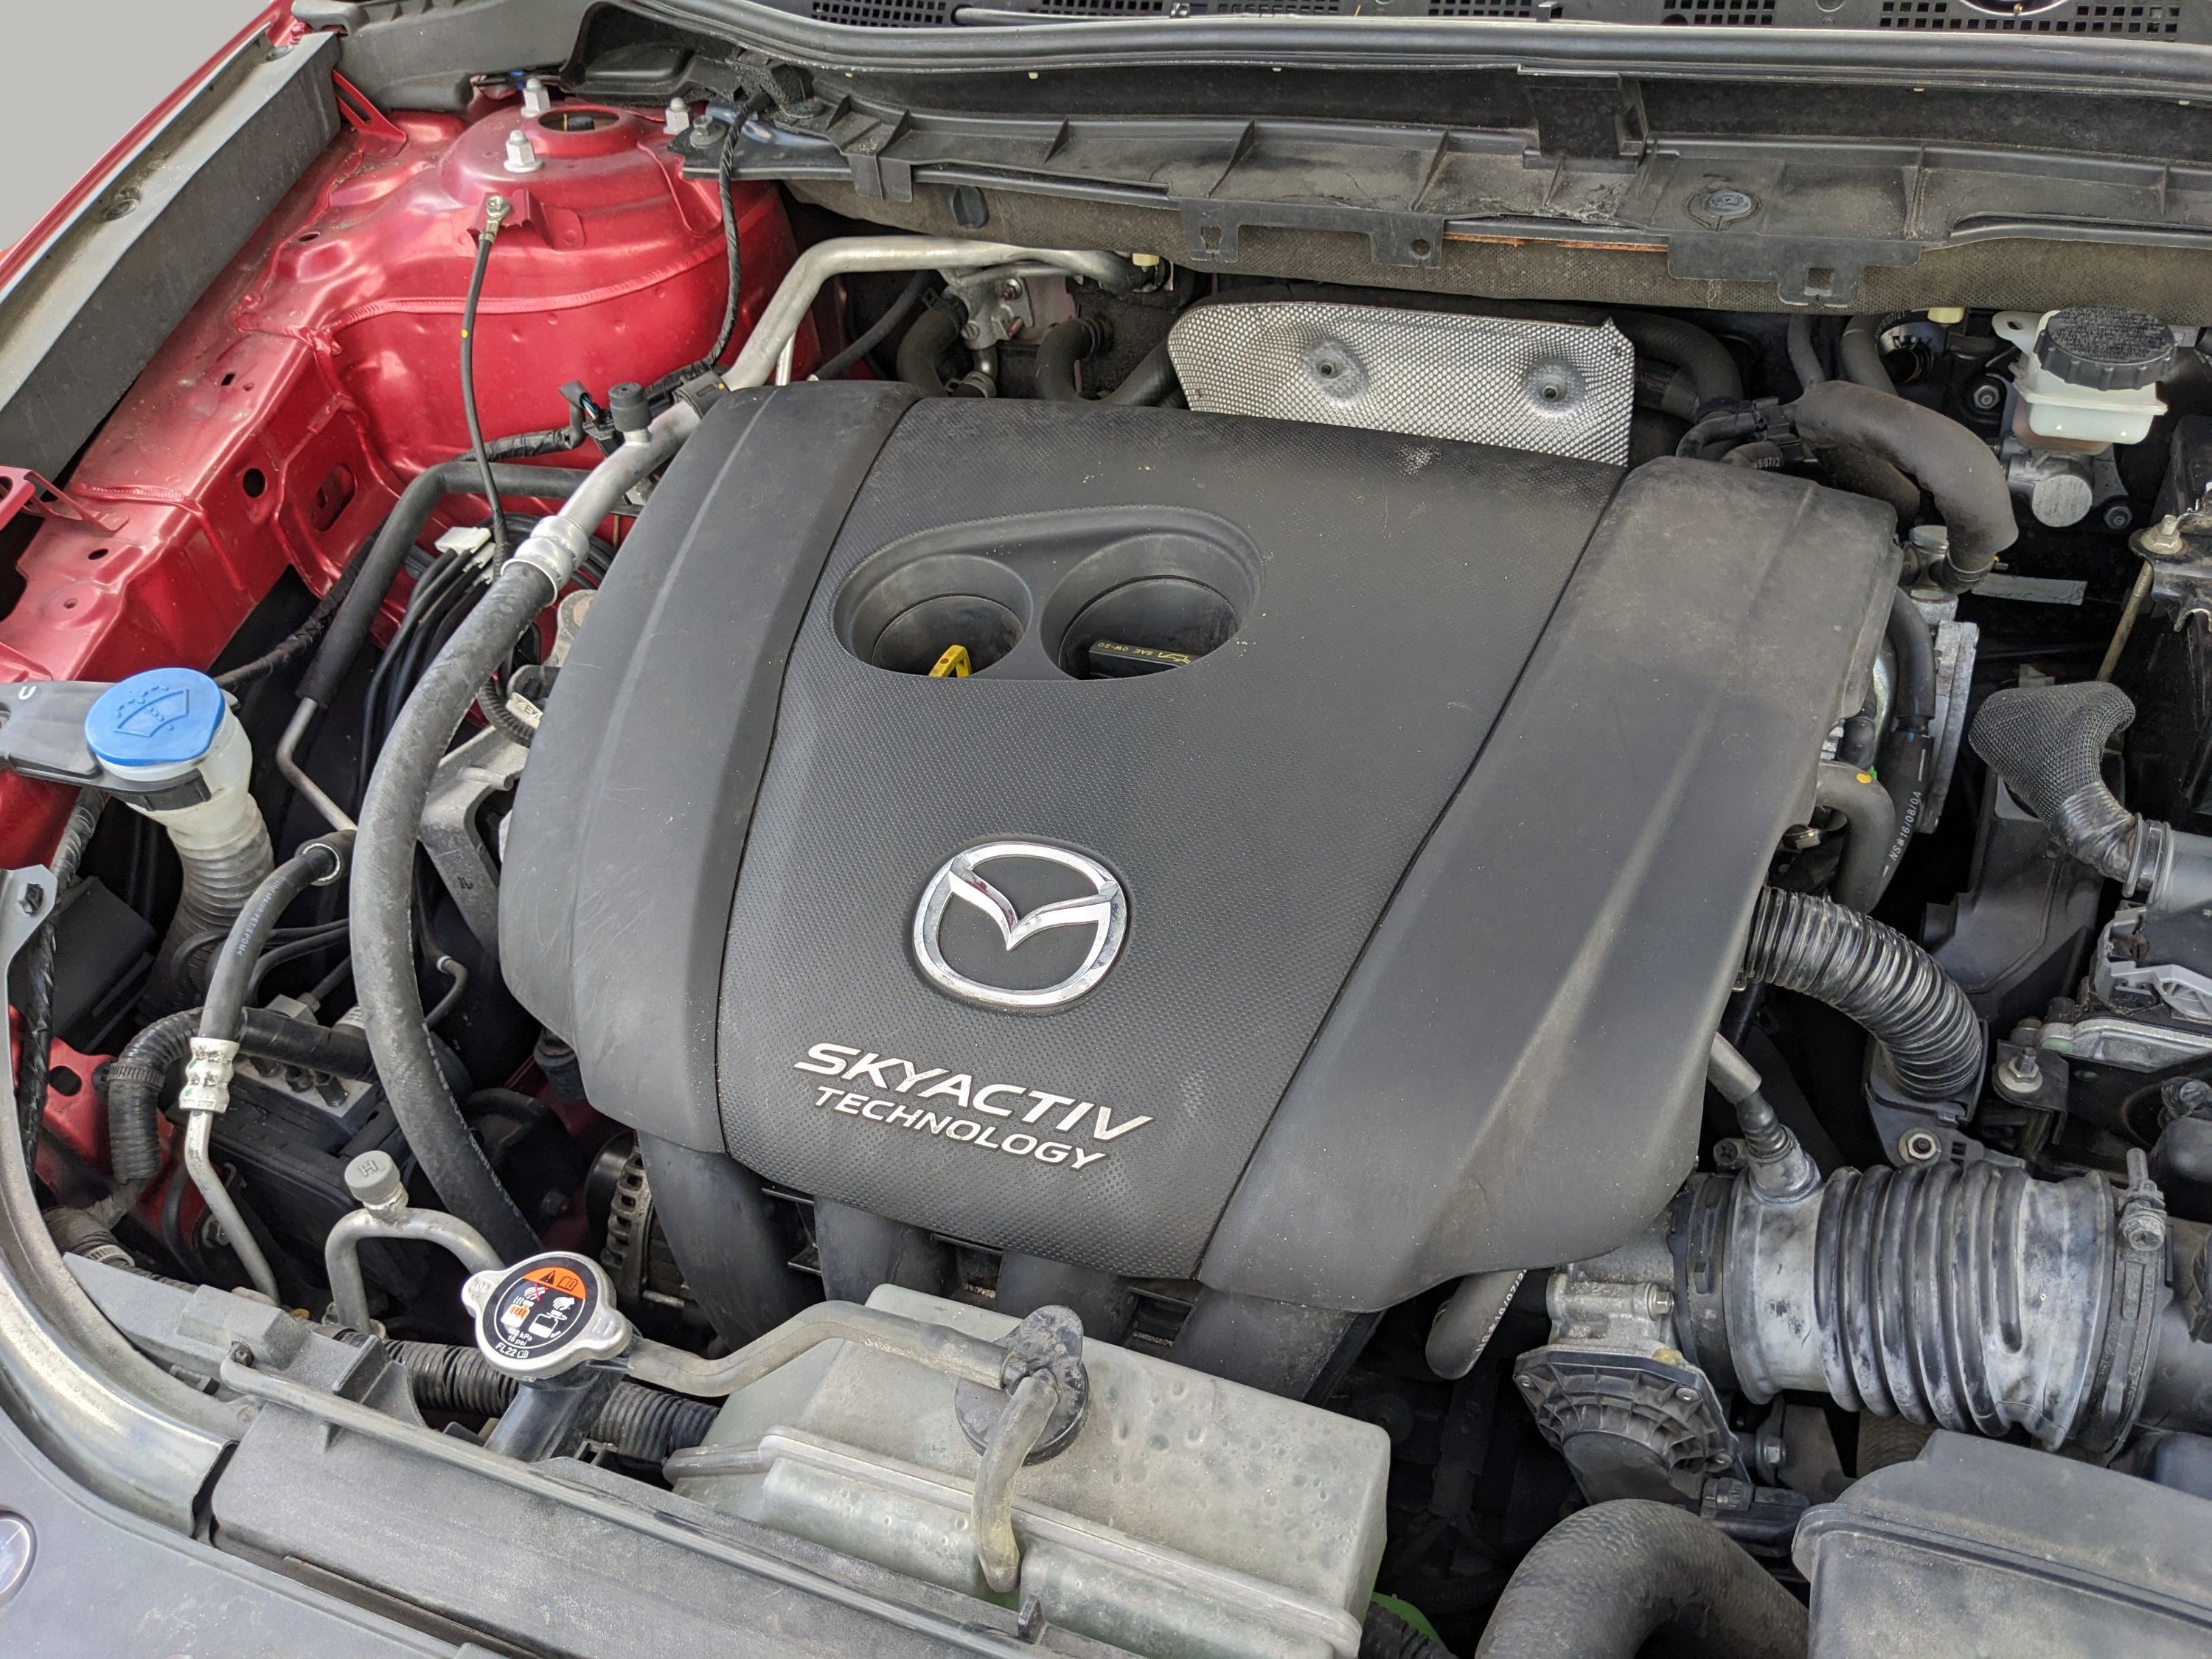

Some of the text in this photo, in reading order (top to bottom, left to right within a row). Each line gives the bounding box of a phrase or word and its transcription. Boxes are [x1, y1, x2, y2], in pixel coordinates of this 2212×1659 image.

[1098, 642, 1129, 652] 0W-20
[794, 1043, 1154, 1141] SKYACTIV
[815, 1085, 1106, 1170] TECHNOLOGY
[359, 1160, 378, 1177] H
[495, 1342, 518, 1357] FL22
[515, 1338, 527, 1347] psi
